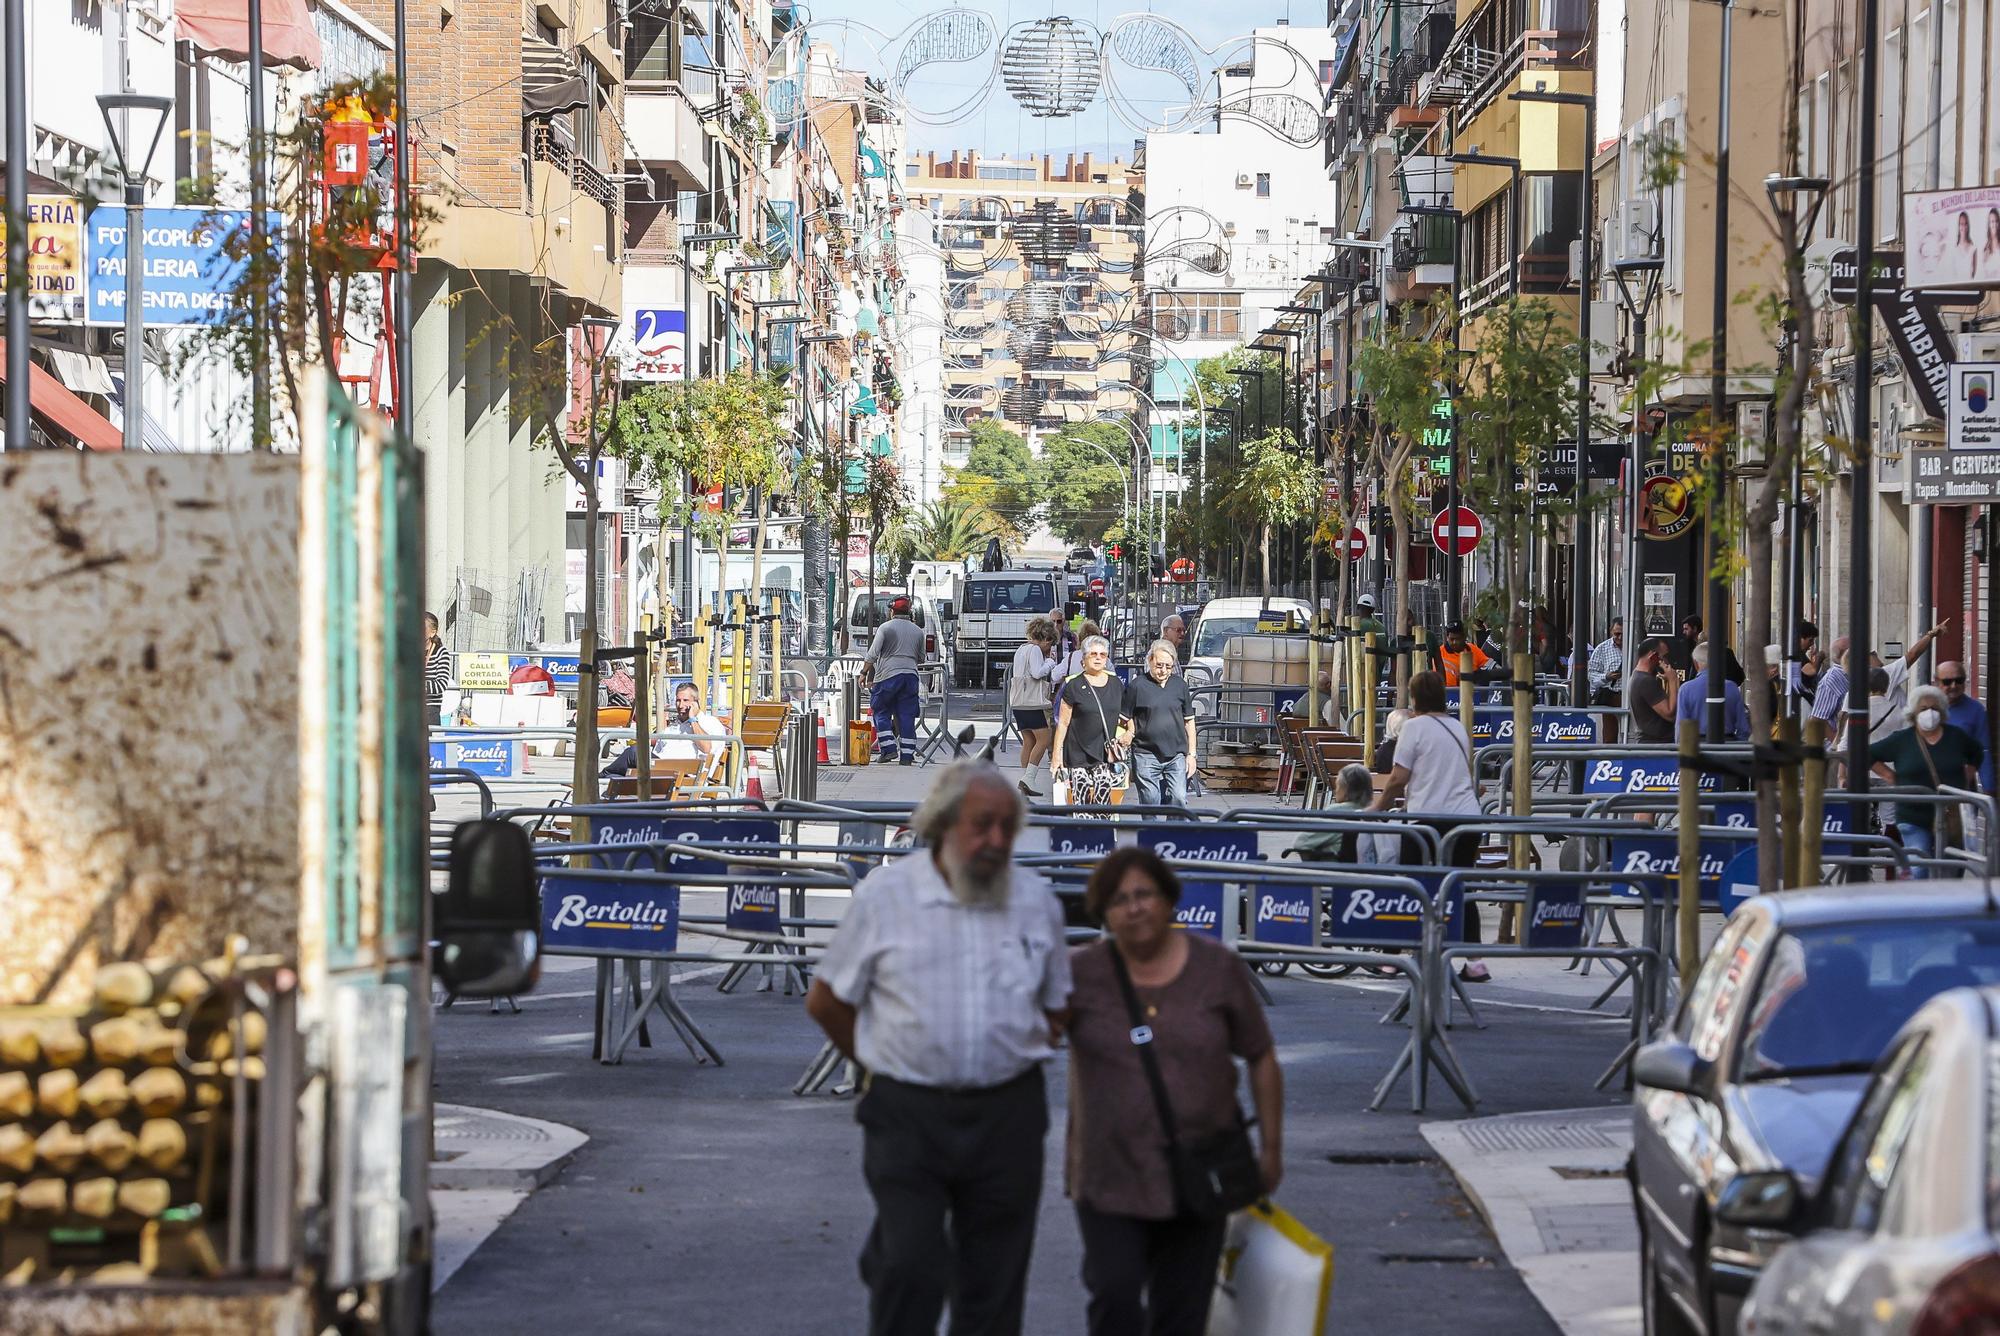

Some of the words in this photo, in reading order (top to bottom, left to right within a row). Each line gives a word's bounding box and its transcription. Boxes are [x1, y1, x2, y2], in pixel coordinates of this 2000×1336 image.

[634, 362, 683, 374] FLEX
[1898, 305, 1948, 414] TABERN
[1672, 454, 1694, 471] DE
[1919, 456, 1942, 476] BAR
[1916, 481, 1940, 499] Tapas
[1946, 480, 1990, 497] Montaditos
